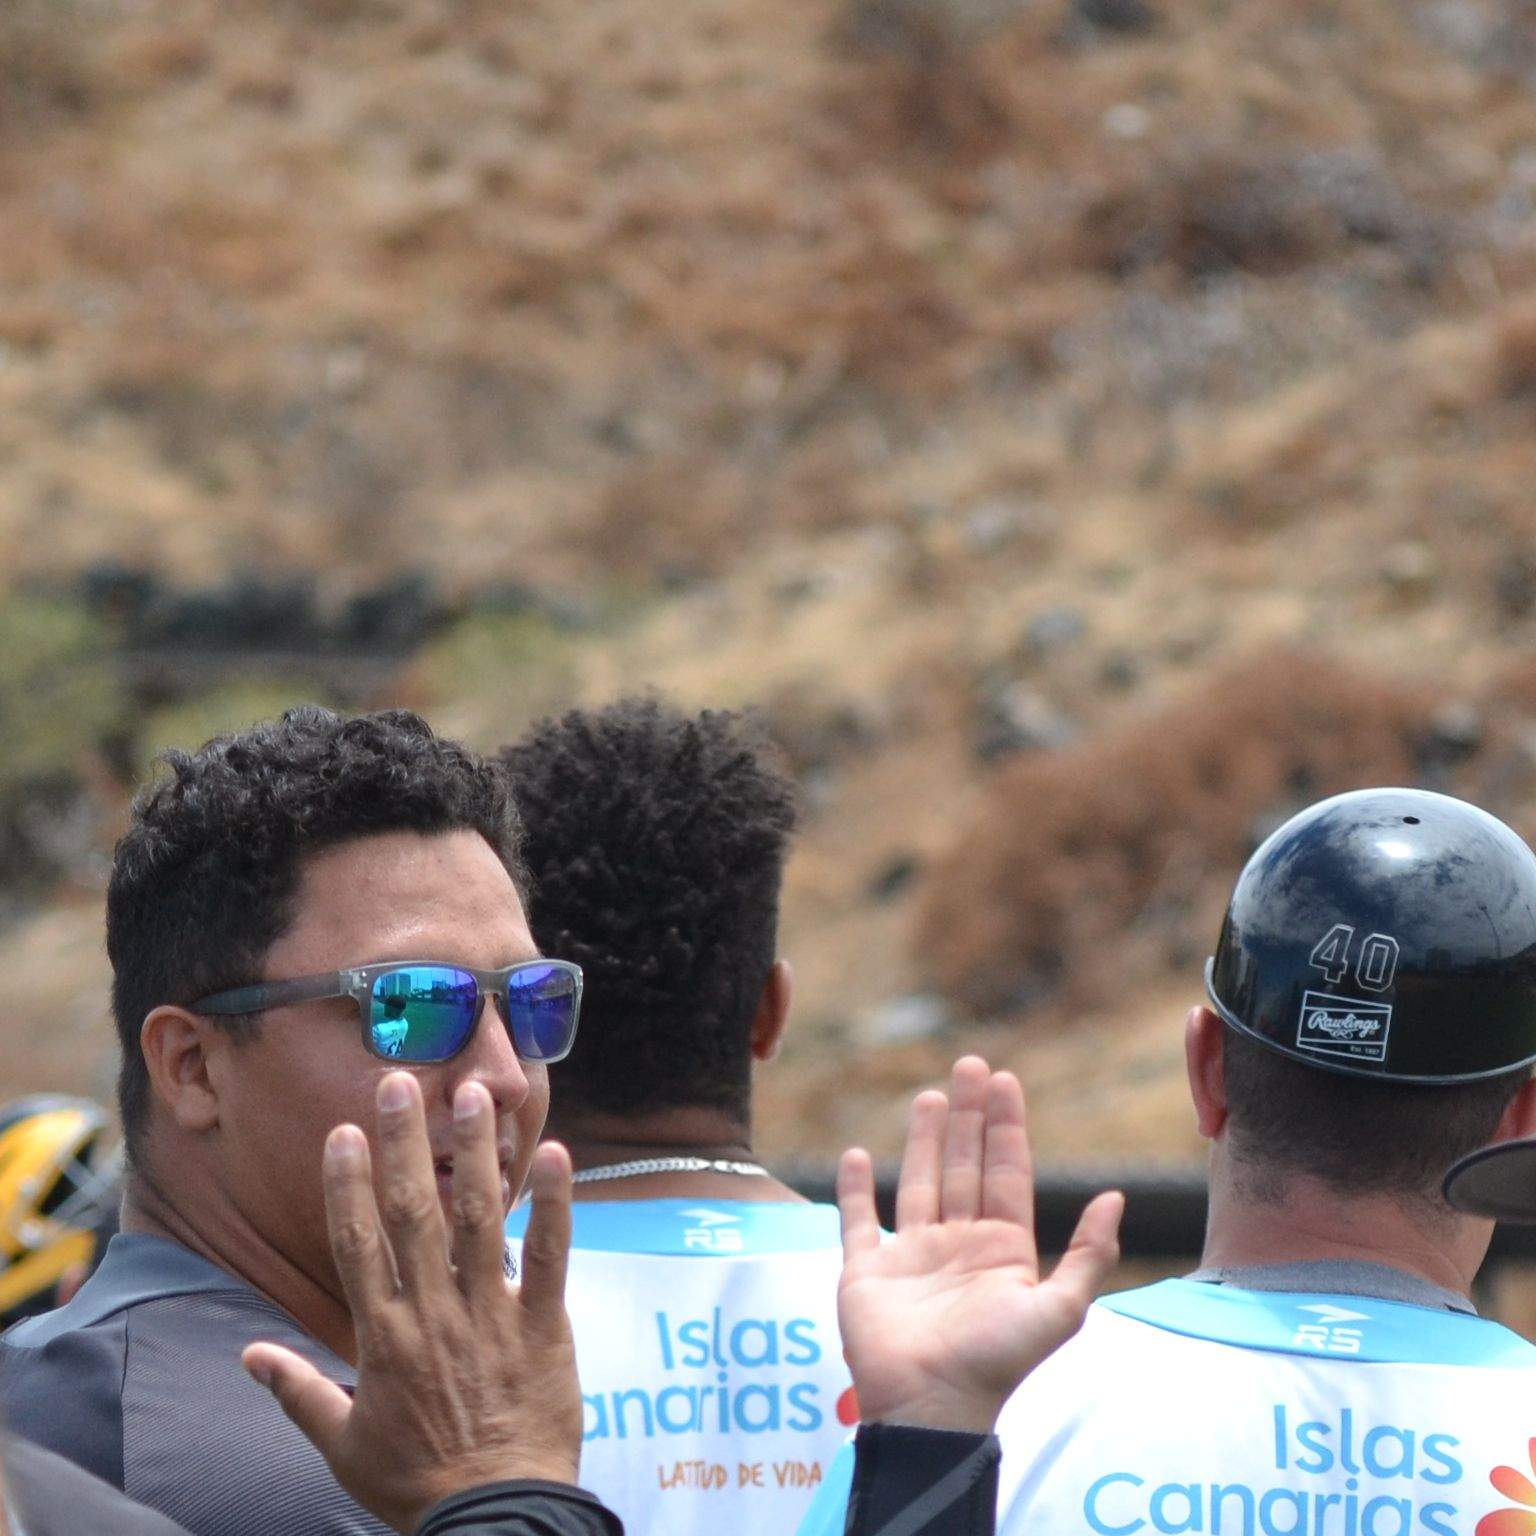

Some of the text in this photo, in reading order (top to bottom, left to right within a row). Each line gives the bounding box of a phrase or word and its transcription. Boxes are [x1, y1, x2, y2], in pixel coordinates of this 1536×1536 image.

[1308, 923, 1400, 992] 40
[1307, 1010, 1381, 1038] Rawlings
[655, 1306, 822, 1369] Islas
[1293, 1325, 1363, 1353] RS
[1273, 1404, 1463, 1485] Islas
[658, 1459, 823, 1490] LATTUD DE VIDA
